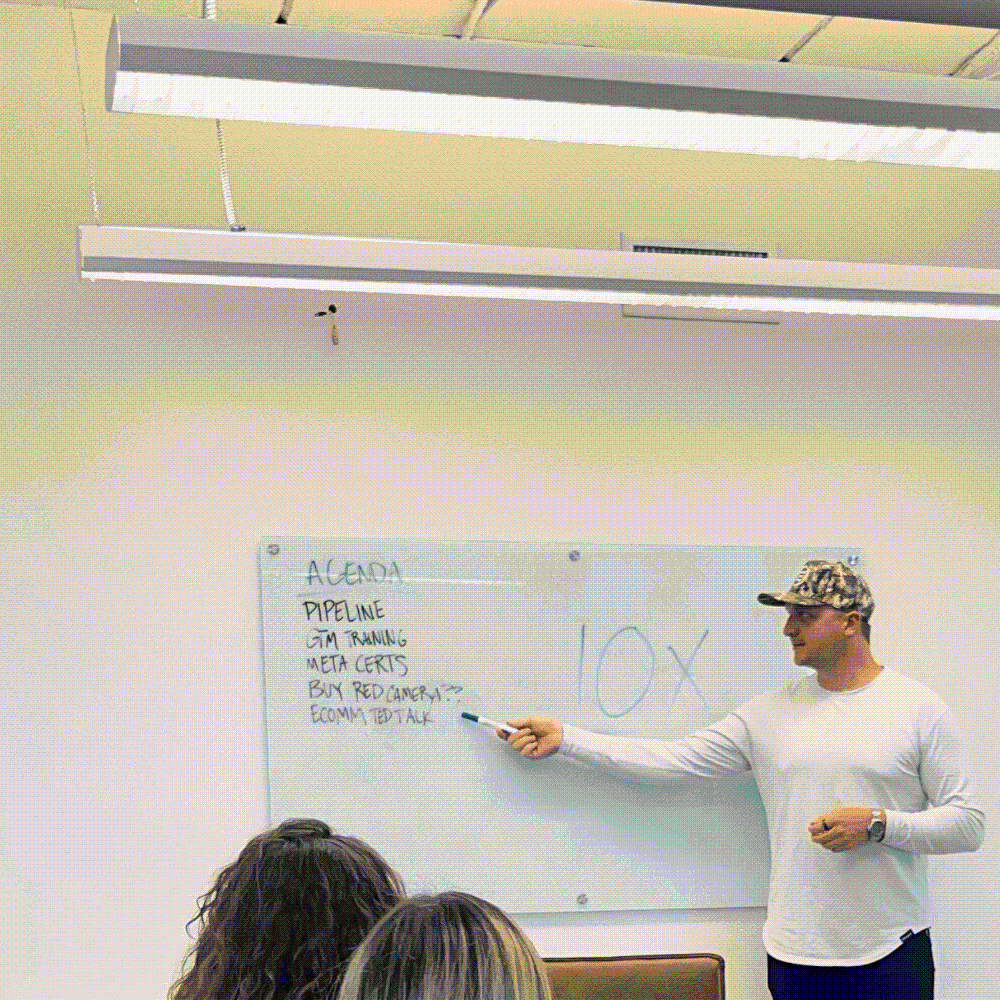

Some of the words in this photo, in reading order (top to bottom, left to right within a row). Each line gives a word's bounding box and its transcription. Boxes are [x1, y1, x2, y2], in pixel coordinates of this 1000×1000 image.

[306, 559, 403, 586] AGENDA
[302, 599, 385, 622] PIPELINE
[306, 628, 339, 650] GTM
[345, 629, 407, 648] TRAINING
[306, 655, 347, 674] META
[355, 654, 408, 676] CERTS
[309, 679, 343, 700] BUY
[352, 681, 383, 701] RED
[310, 704, 367, 725] ECOMM
